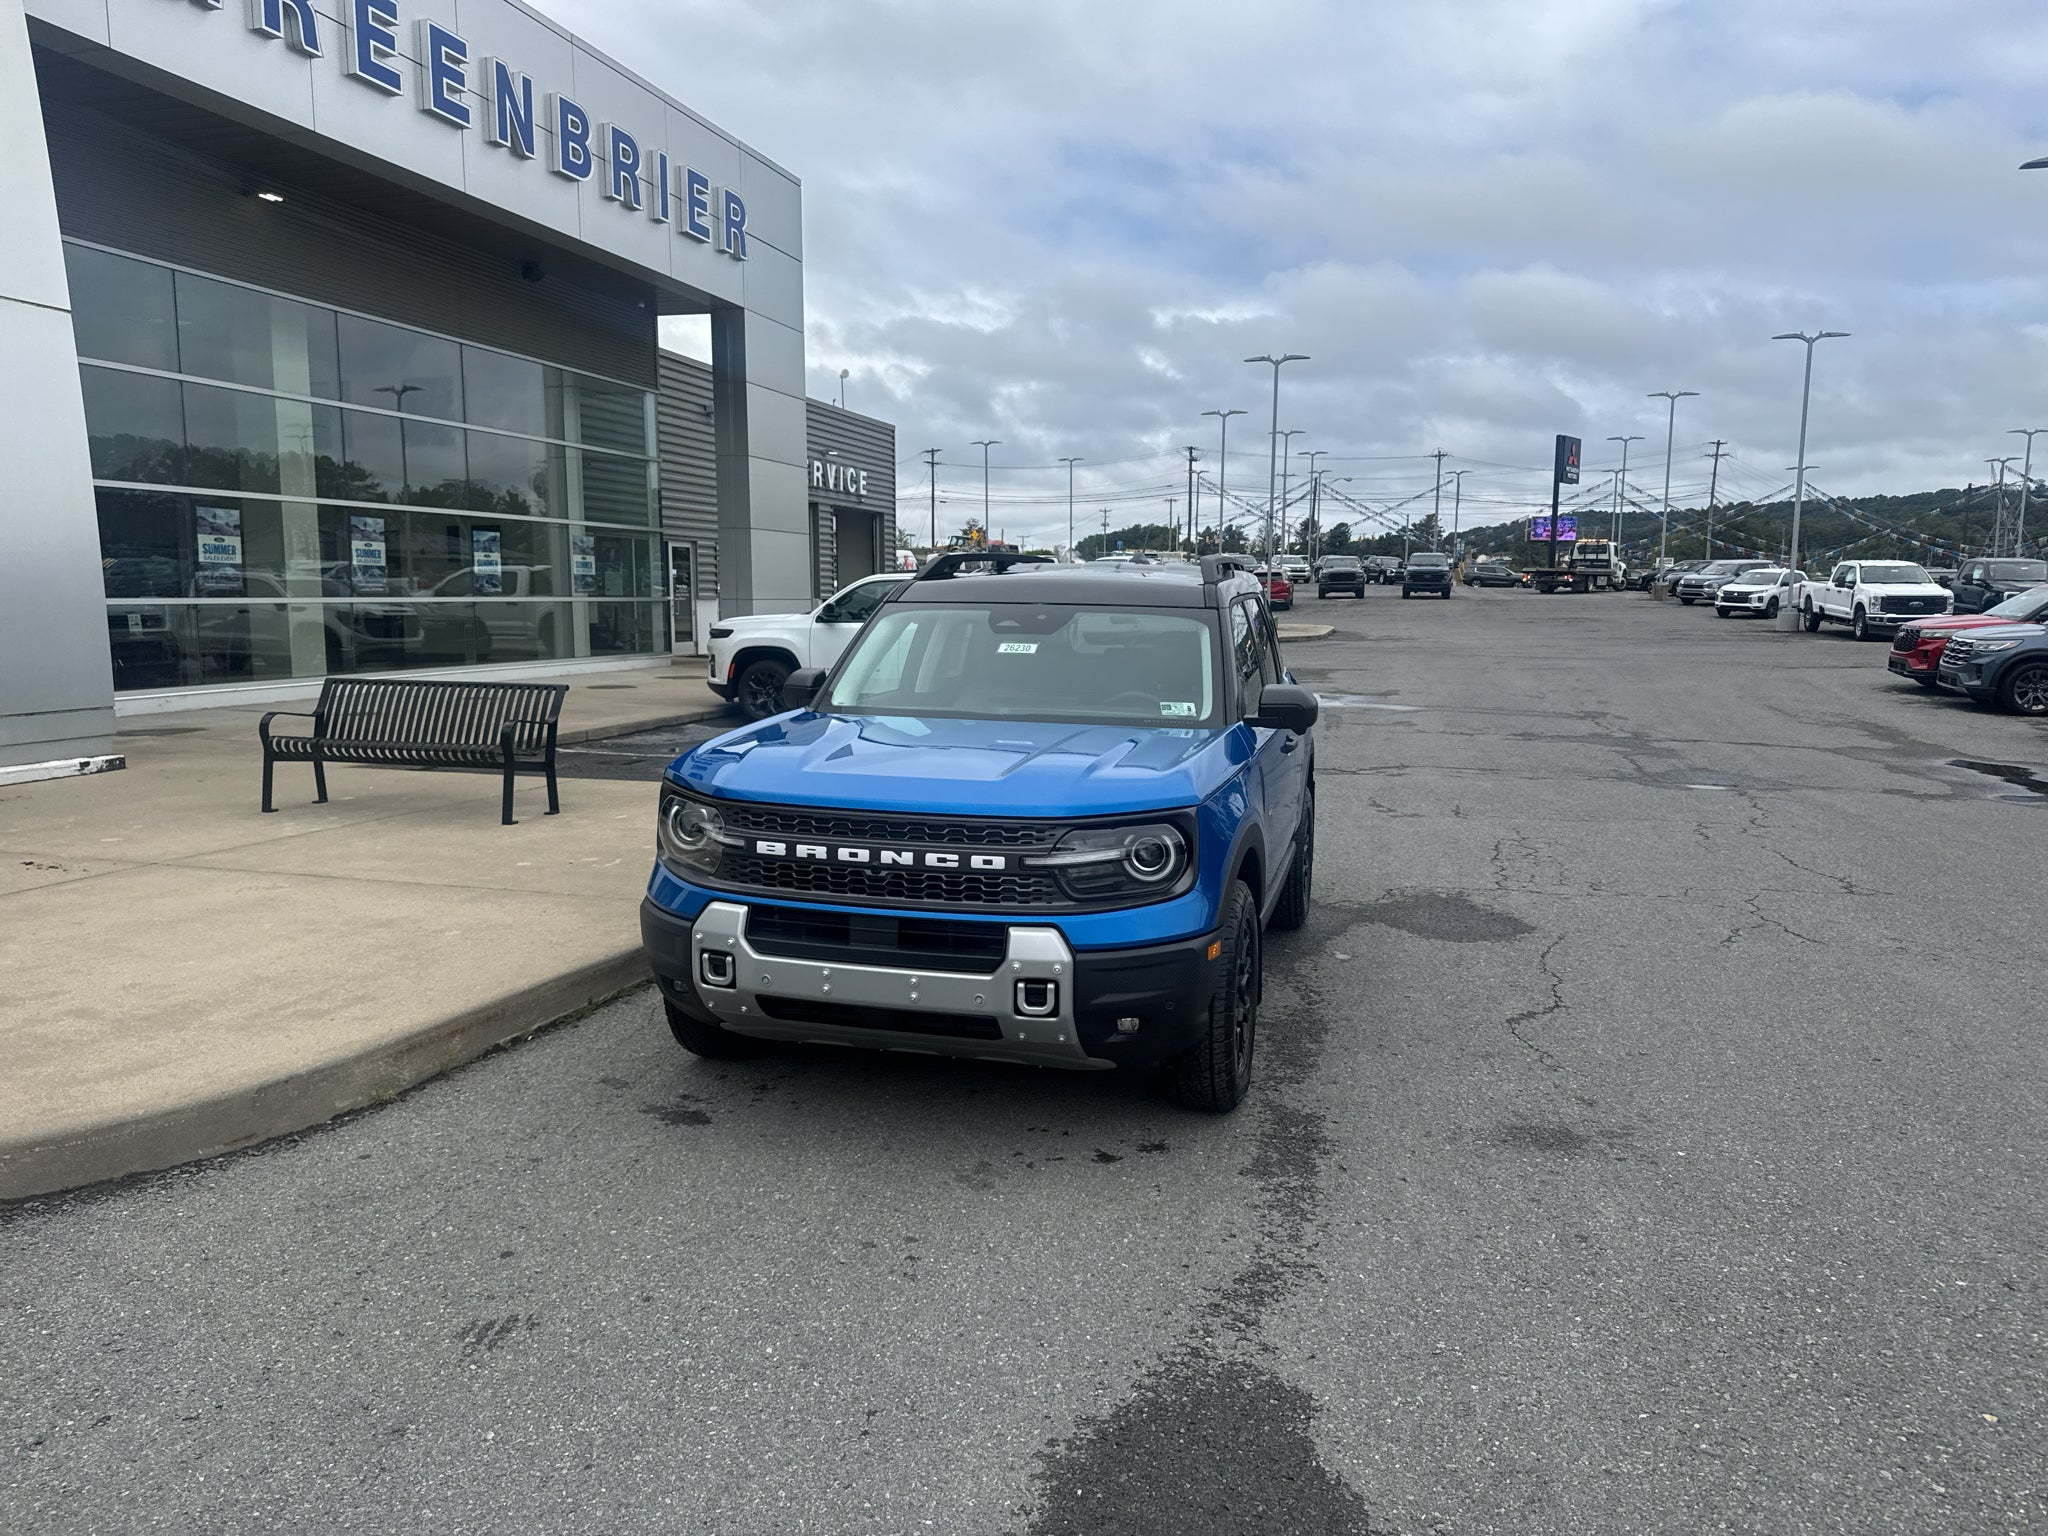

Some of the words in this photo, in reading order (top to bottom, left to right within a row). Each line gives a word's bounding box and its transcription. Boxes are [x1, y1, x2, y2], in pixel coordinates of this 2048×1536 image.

[203, 0, 748, 261] EENBRIER
[807, 459, 867, 495] RVICE
[202, 543, 236, 555] SUMMER
[355, 548, 381, 559] SUMMER
[756, 840, 1005, 870] BRONCO
